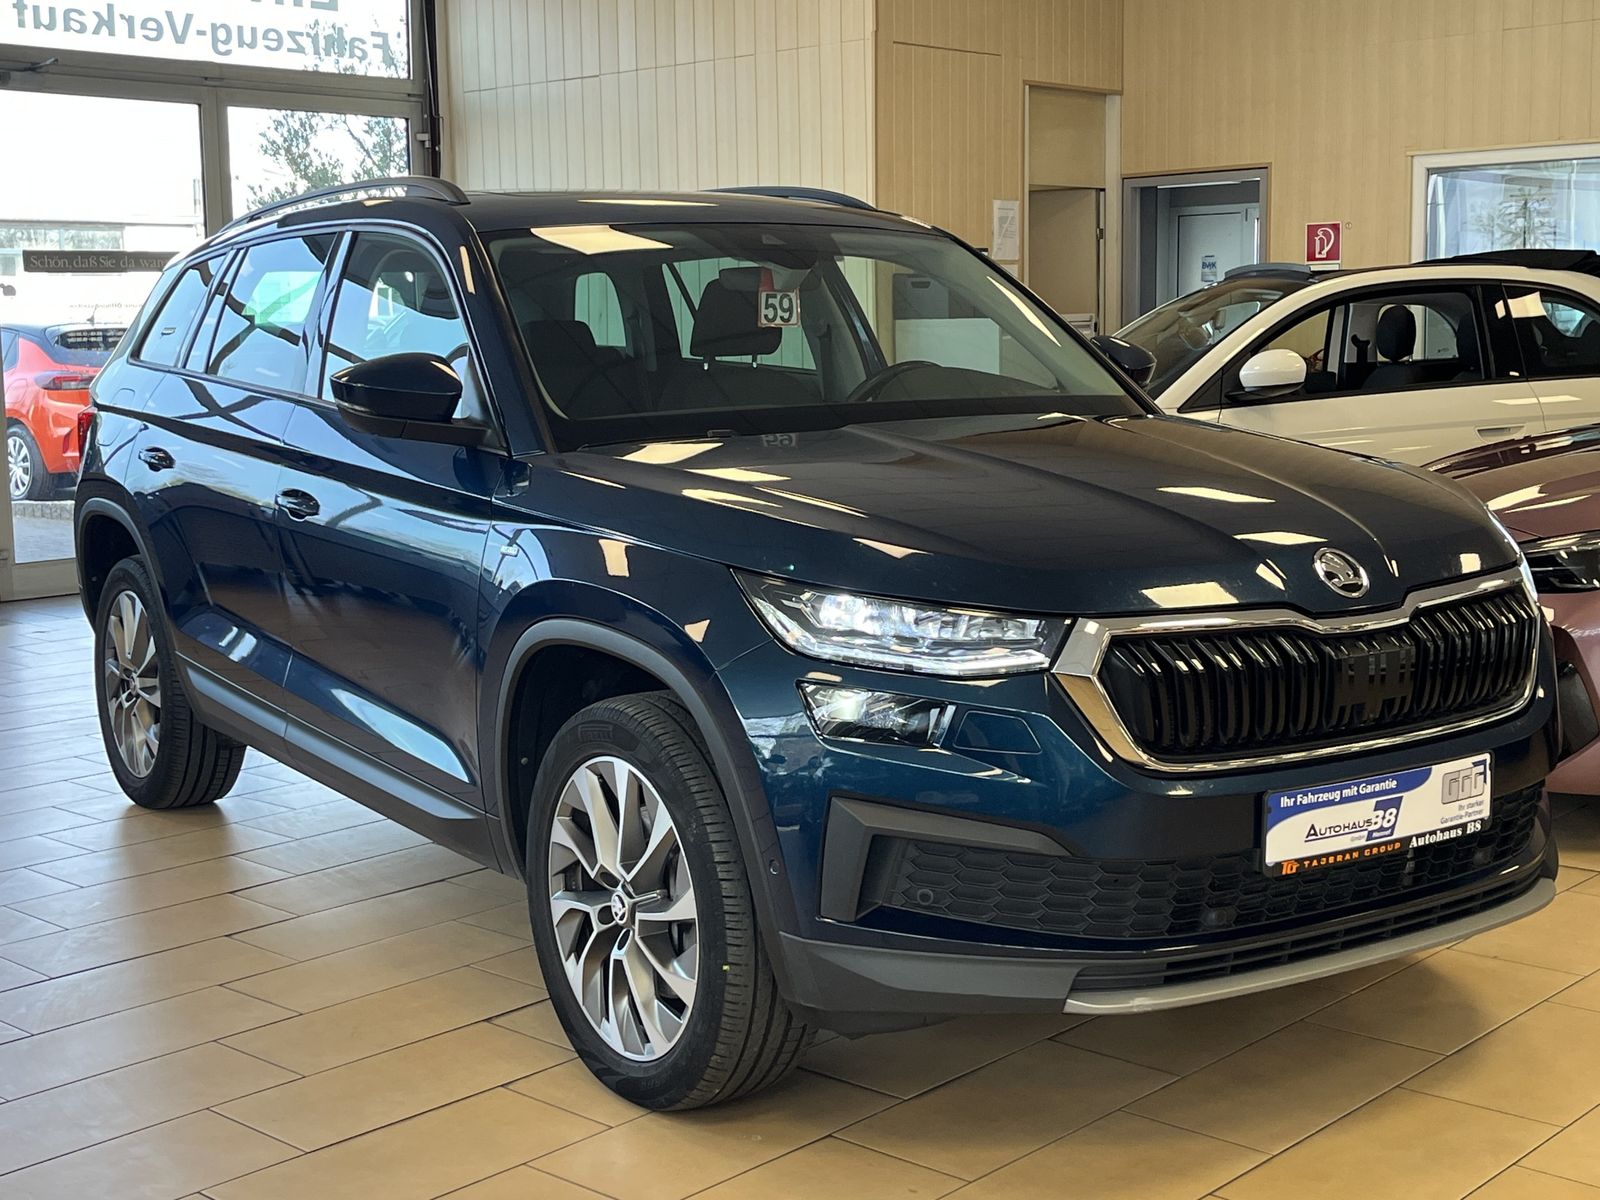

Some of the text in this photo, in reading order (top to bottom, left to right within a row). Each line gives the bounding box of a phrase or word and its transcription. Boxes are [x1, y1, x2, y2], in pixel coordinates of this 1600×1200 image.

[30, 255, 73, 269] Schön,
[73, 255, 98, 269] daß
[99, 255, 117, 269] Sie
[119, 256, 136, 269] da
[763, 293, 794, 324] 59
[1280, 778, 1397, 808] Ihr Fahrzeug mit Garantie
[1409, 820, 1482, 849] Autohaus B8
[1364, 842, 1402, 857] GROUP
